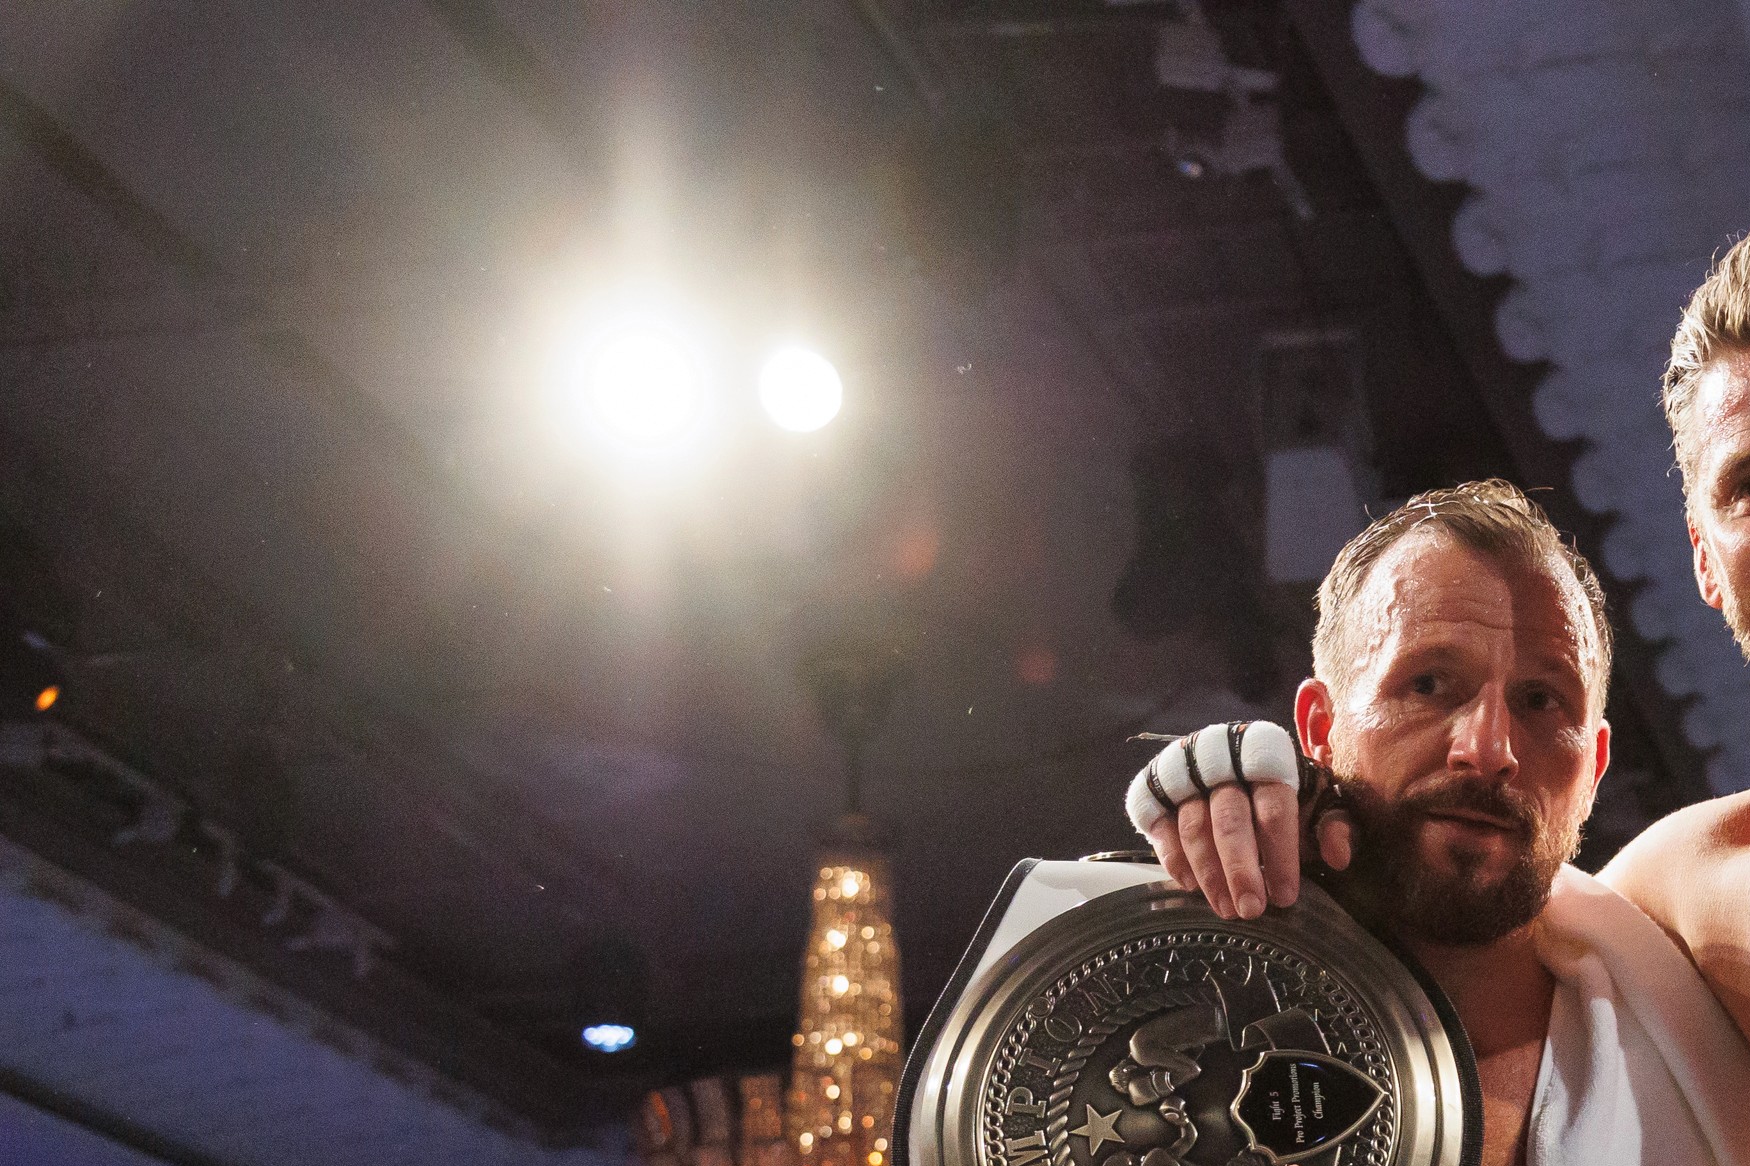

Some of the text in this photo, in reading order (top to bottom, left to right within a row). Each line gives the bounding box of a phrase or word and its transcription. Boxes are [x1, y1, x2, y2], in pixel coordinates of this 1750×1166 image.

[1289, 1063, 1307, 1144] Pro Project Promotions
[1313, 1082, 1326, 1119] Champion
